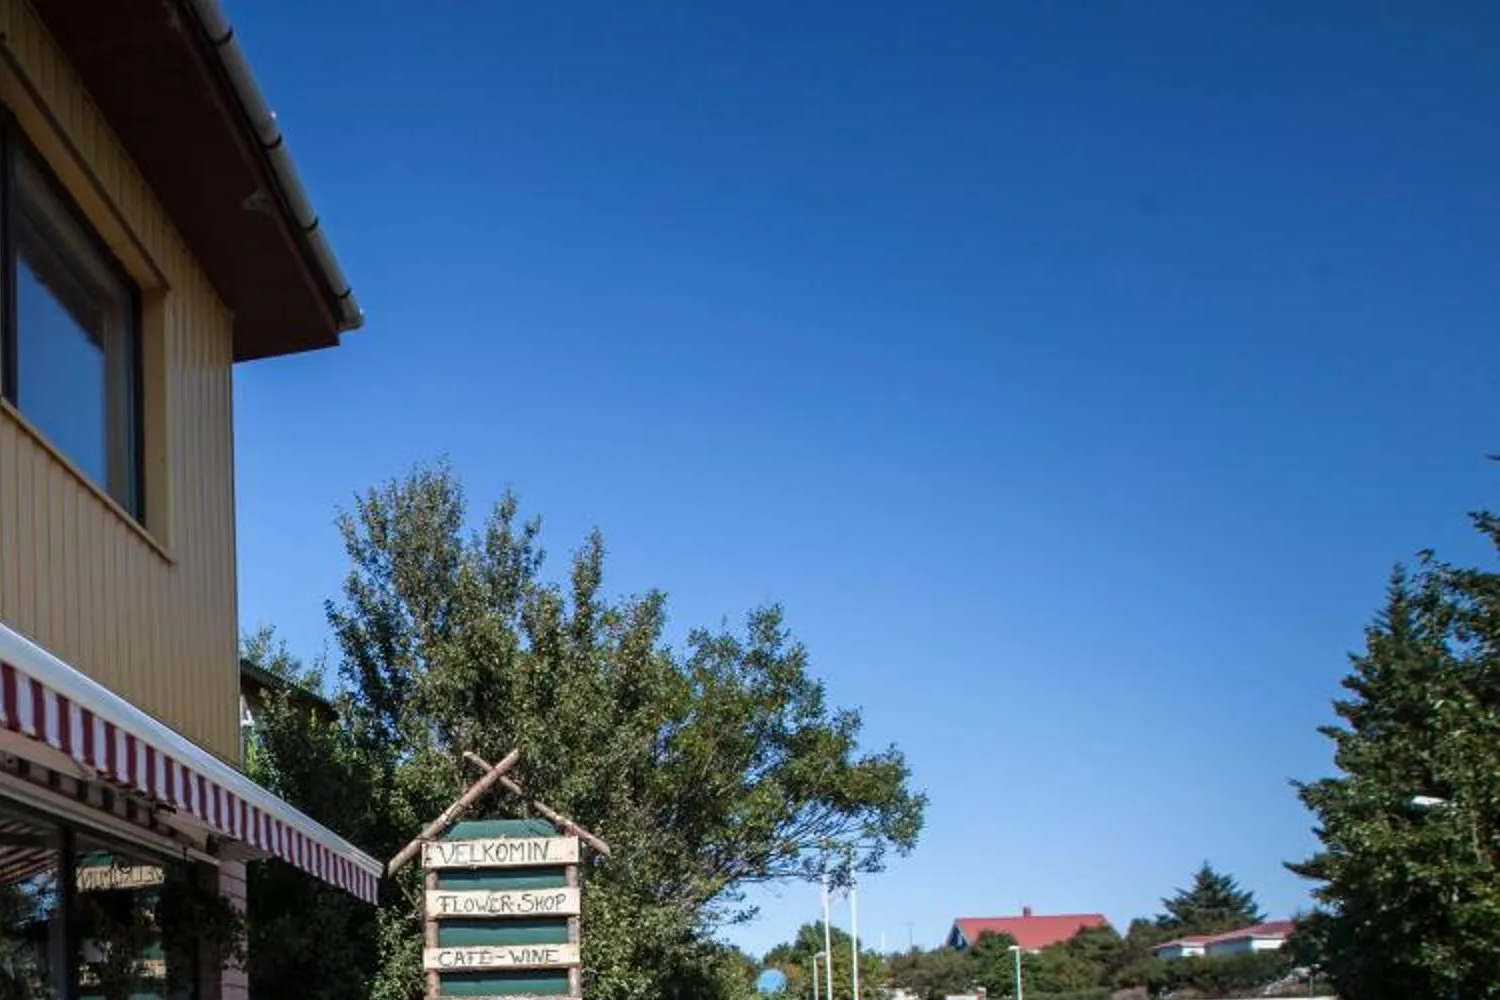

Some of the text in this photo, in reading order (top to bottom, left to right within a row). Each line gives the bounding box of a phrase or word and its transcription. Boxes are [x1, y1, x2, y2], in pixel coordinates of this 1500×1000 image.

[436, 892, 567, 913] FLOWER SHOP
[508, 948, 559, 964] WINE
